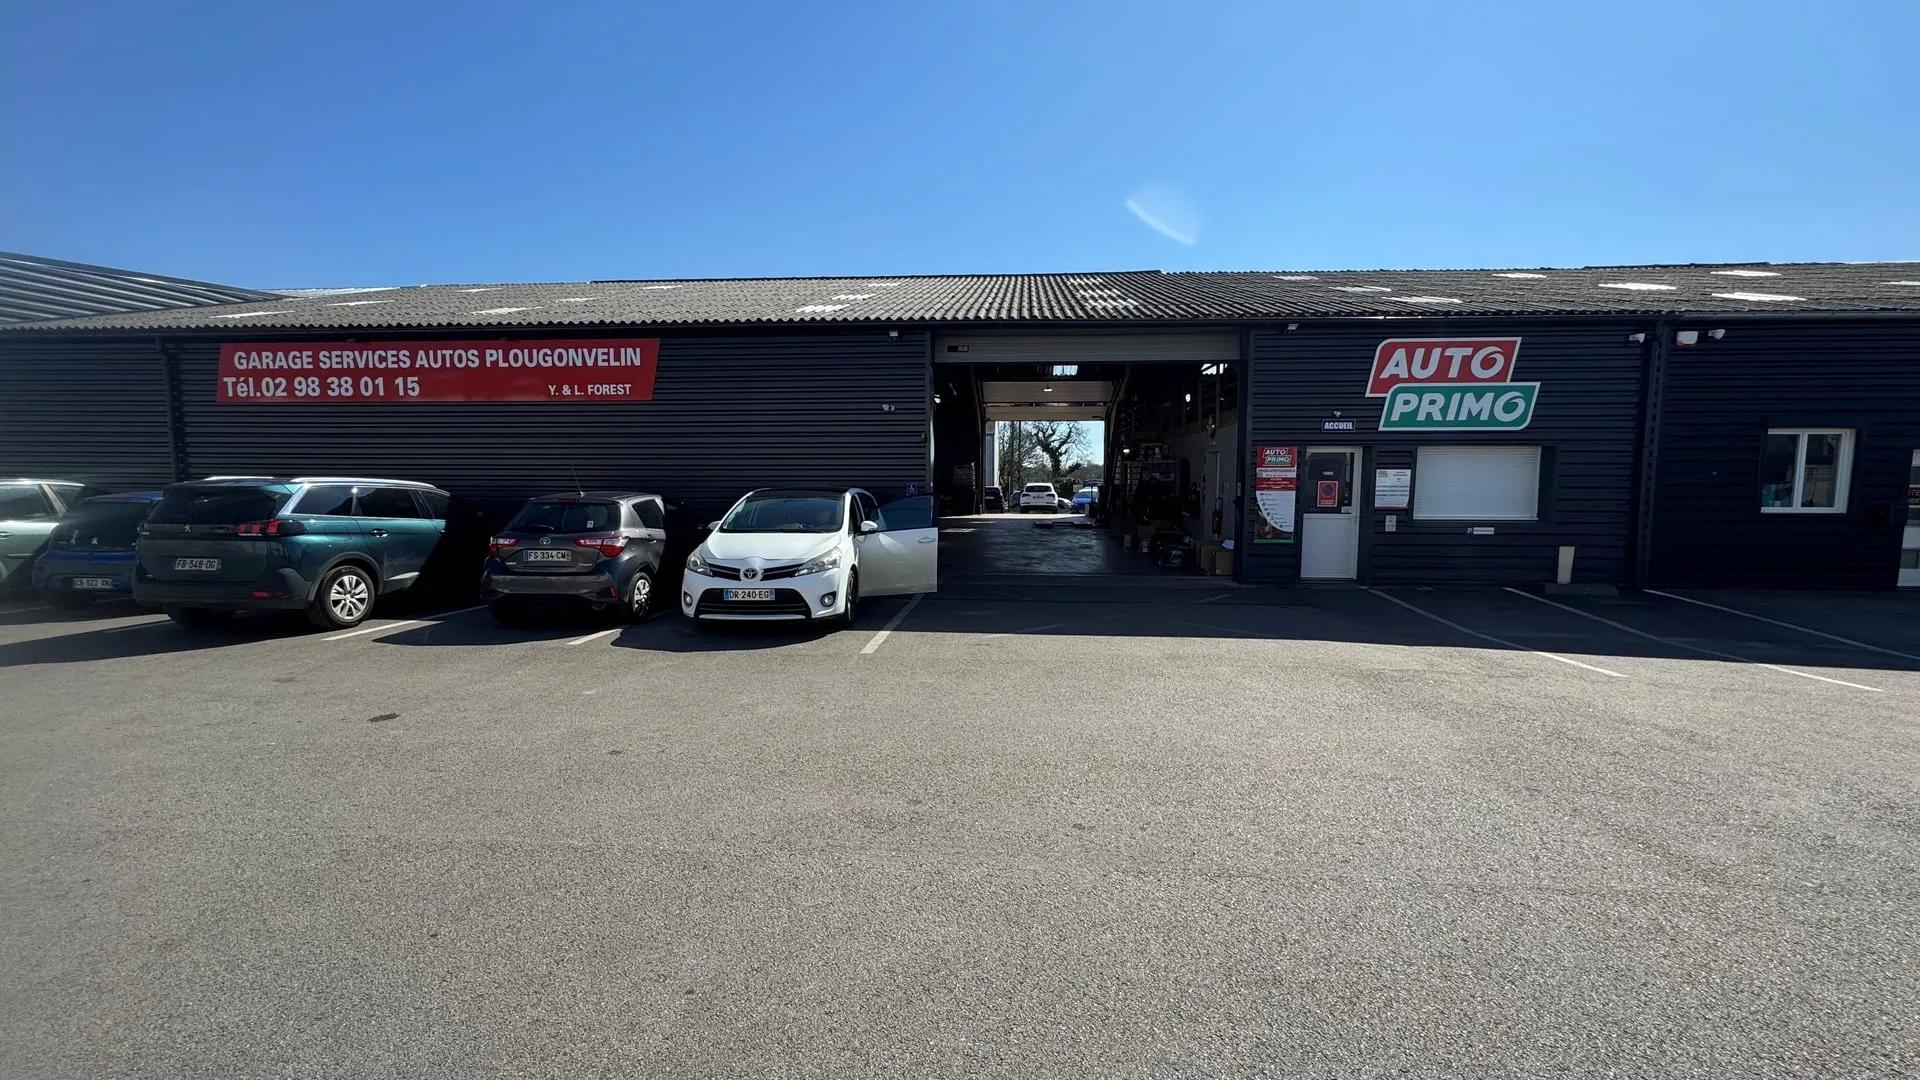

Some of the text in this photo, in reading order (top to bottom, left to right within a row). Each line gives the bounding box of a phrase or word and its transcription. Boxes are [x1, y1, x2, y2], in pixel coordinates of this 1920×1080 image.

[233, 347, 641, 369] GARAGE SERVICES AUTOS PLOUGONVELIN
[1379, 346, 1505, 379] AUTO
[293, 376, 320, 397] 98
[327, 376, 354, 397] 38
[359, 376, 385, 397] 01
[394, 376, 420, 397] 15
[548, 383, 632, 395] Y. & L. FOREST
[1390, 391, 1526, 422] PRIMO
[1324, 421, 1353, 430] ACCUEIL
